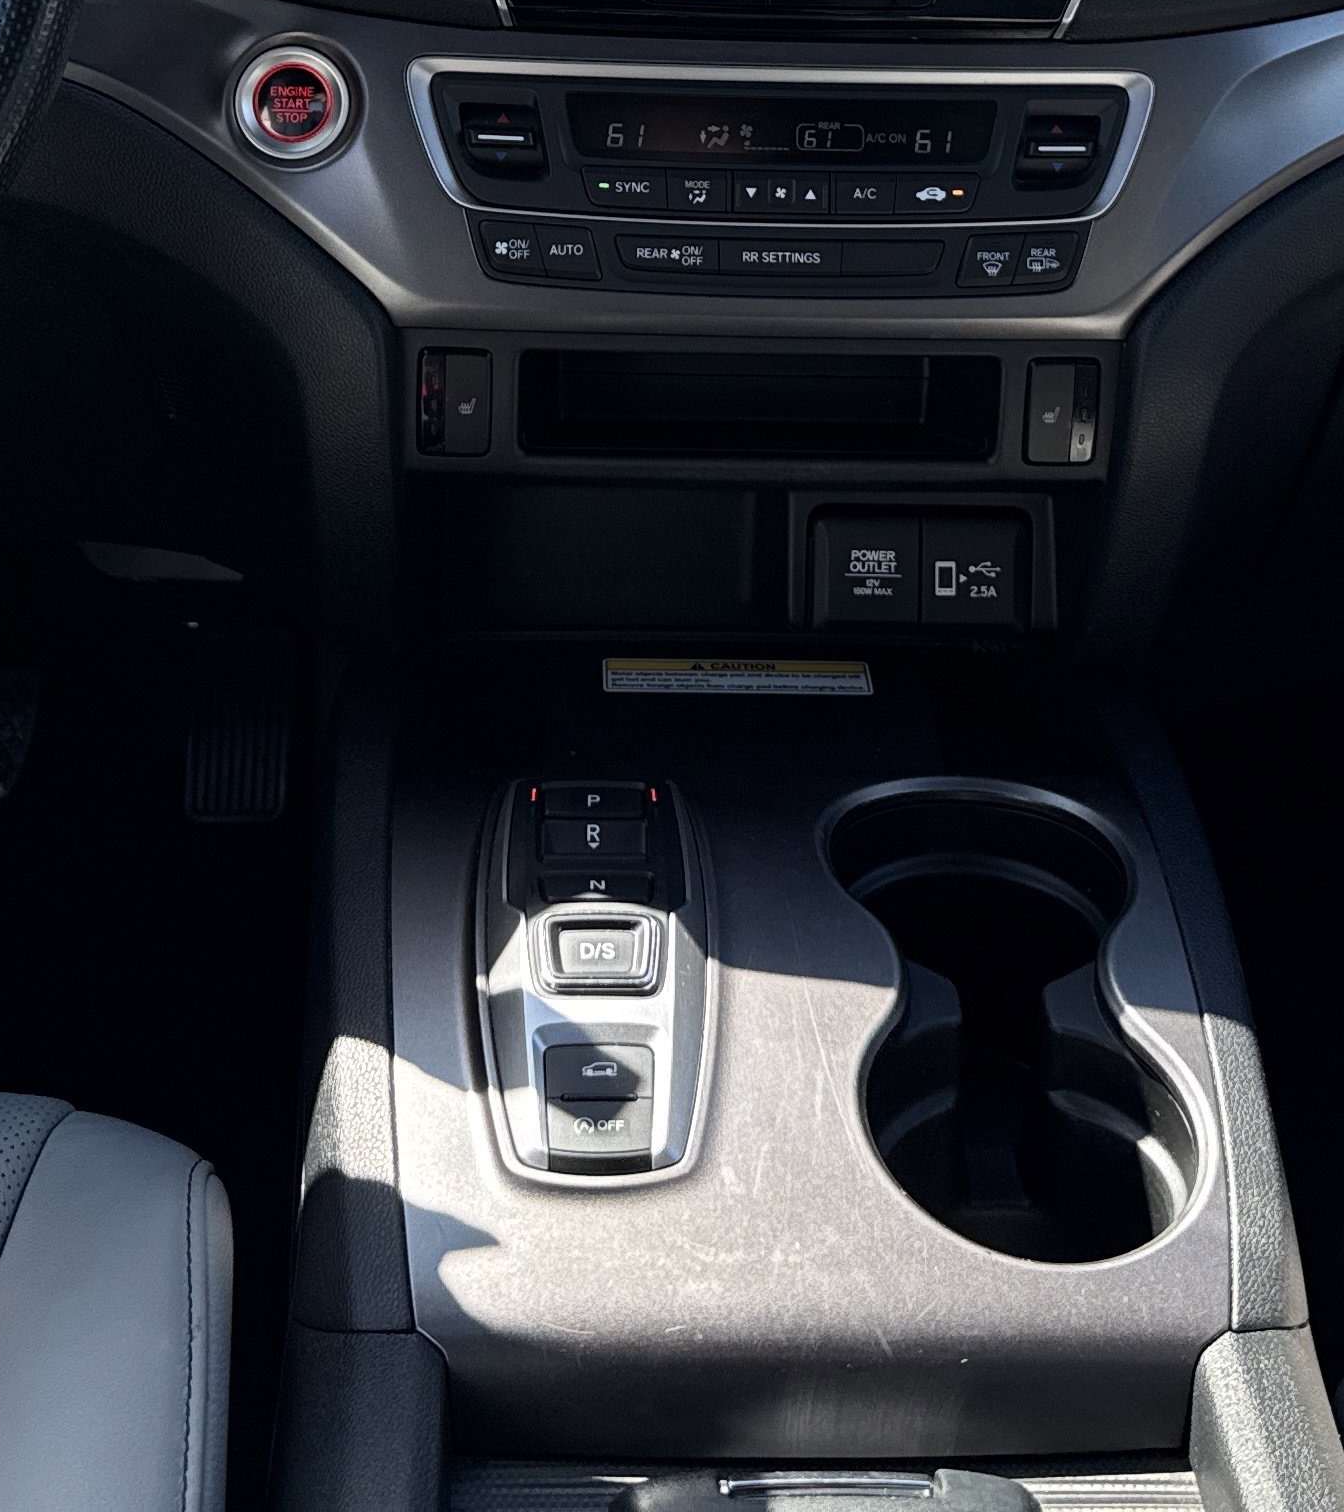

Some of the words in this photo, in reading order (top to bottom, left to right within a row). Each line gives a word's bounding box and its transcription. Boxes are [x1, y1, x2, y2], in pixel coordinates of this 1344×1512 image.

[270, 86, 315, 96] ENGINE
[273, 99, 311, 109] START
[276, 112, 308, 123] STOP
[818, 121, 841, 130] REAR
[866, 133, 887, 144] A/C
[888, 133, 907, 144] ON
[615, 180, 651, 194] SYNC
[684, 180, 711, 189] MODE
[853, 188, 878, 200] A/C
[508, 239, 530, 249] ON/
[508, 250, 531, 260] OFF
[549, 244, 584, 256] AUTO
[636, 247, 668, 259] REAR
[681, 245, 703, 255] ON/
[1030, 247, 1057, 258] REAR
[681, 256, 703, 266] OFF
[742, 251, 759, 263] RR
[761, 251, 821, 264] SETTINGS
[977, 251, 1011, 261] FRONT
[850, 550, 896, 561] POWER
[849, 561, 897, 573] OUTLET
[969, 586, 997, 598] 2.5A
[710, 662, 776, 671] CAUTION
[586, 794, 601, 807] P
[586, 824, 601, 842] R
[589, 879, 605, 891] N
[579, 942, 616, 960] D/S
[597, 1119, 624, 1131] OFF
